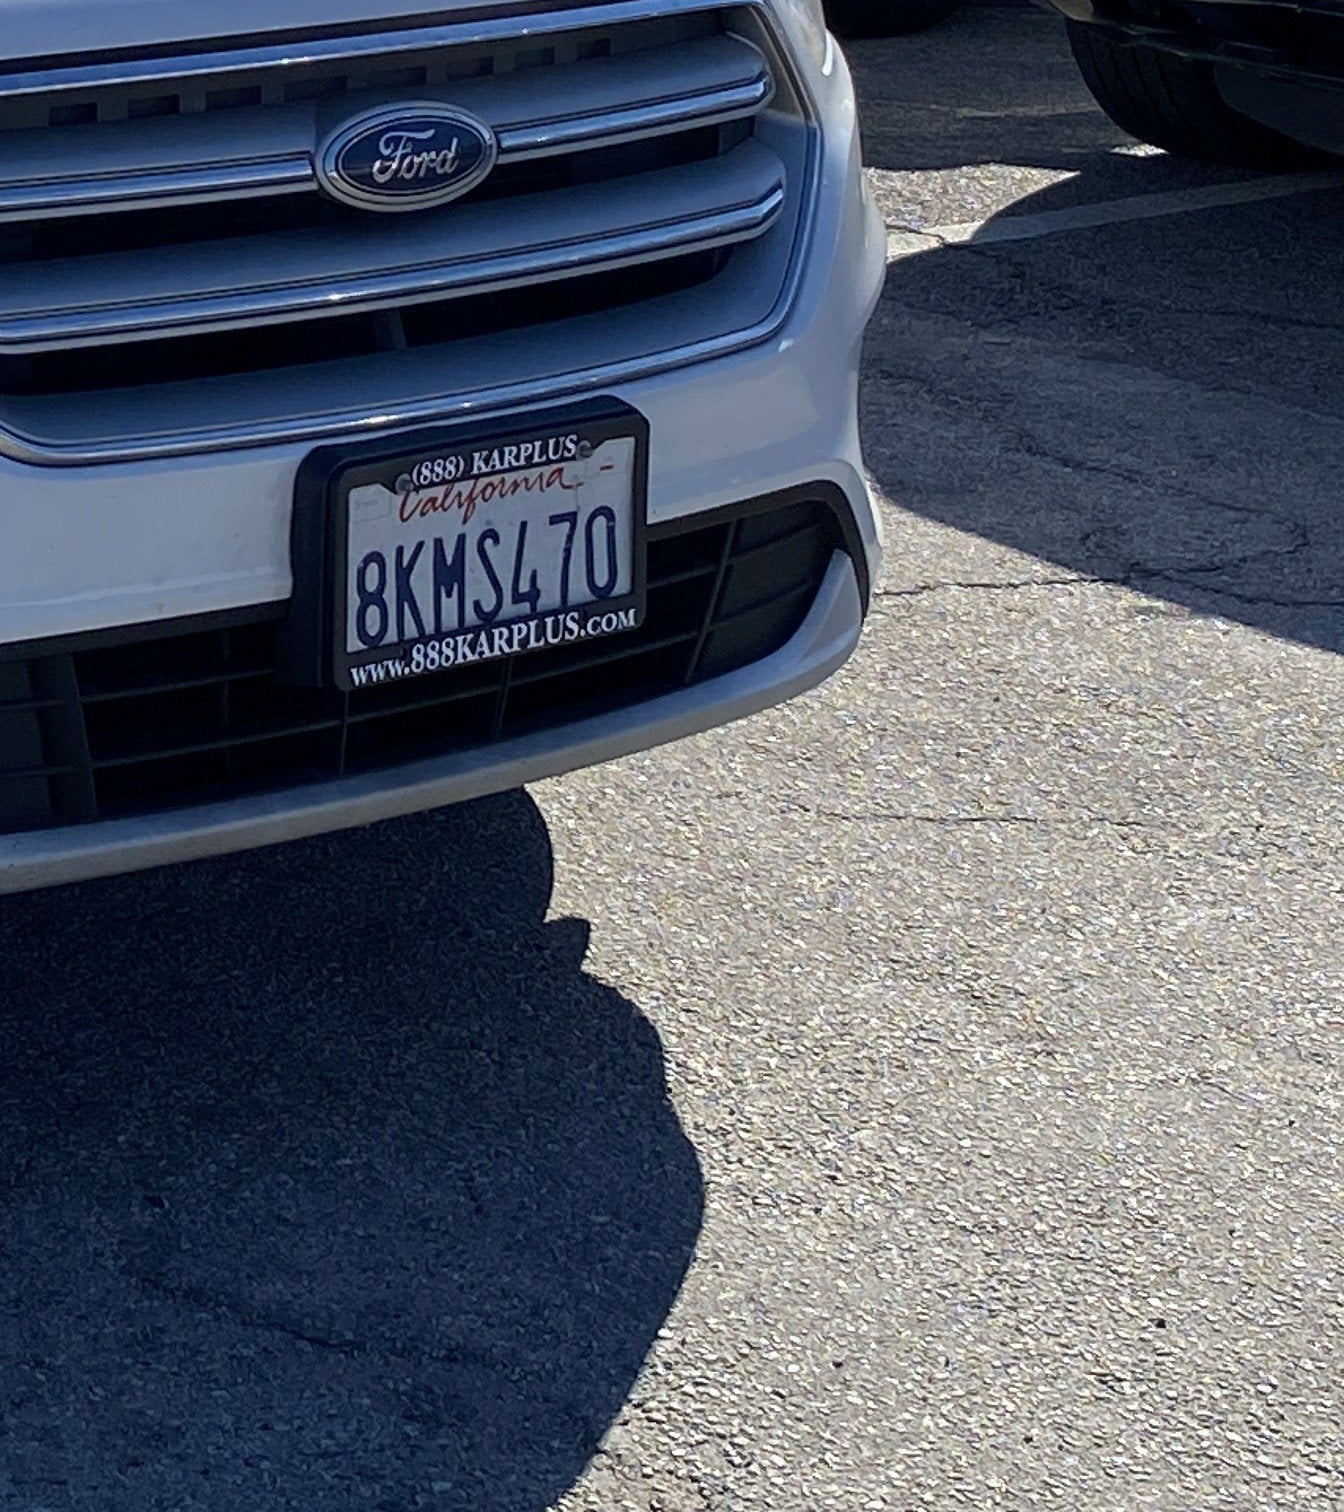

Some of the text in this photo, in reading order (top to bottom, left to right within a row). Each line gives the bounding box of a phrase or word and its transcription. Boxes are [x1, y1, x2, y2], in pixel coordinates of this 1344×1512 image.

[372, 128, 460, 184] Ford
[412, 434, 579, 486] (888) KARPLUS
[398, 467, 584, 526] California
[356, 505, 618, 649] 8KMS470
